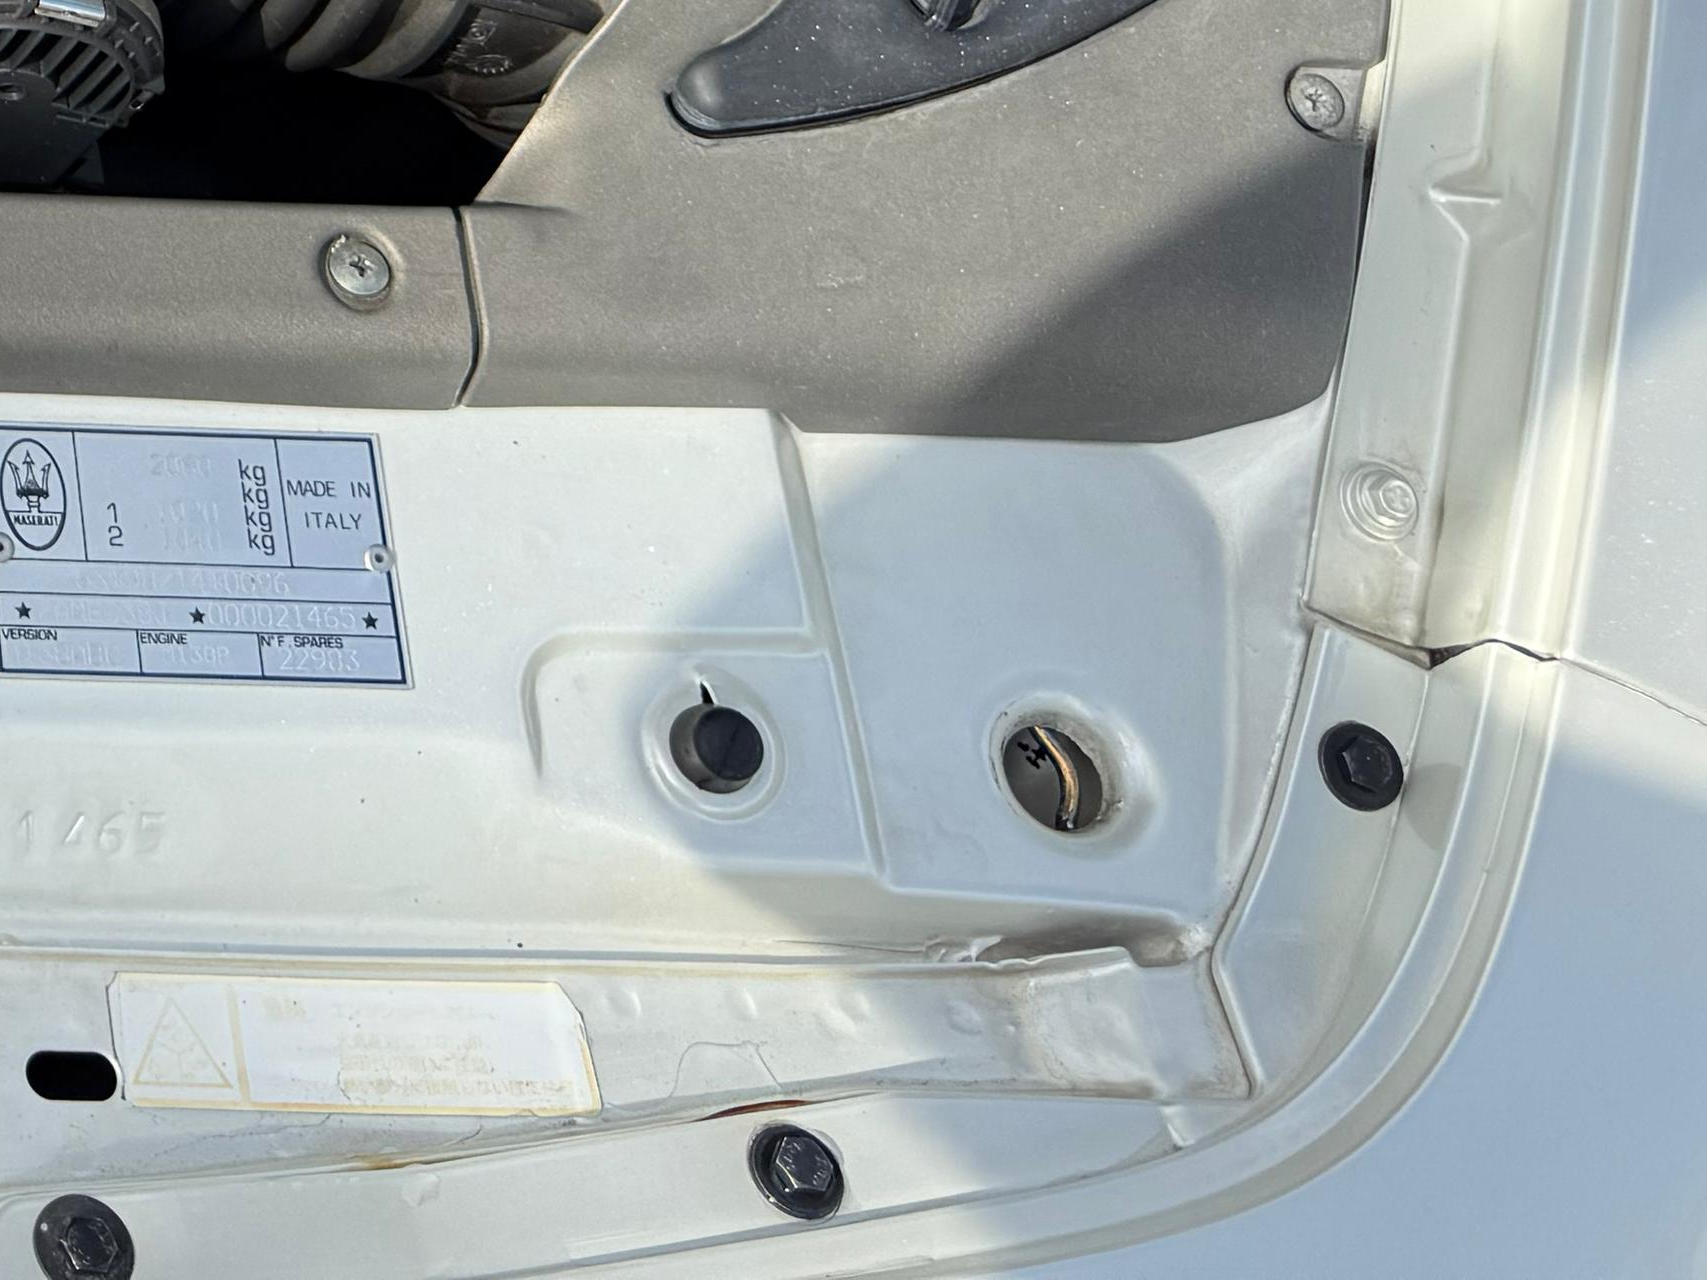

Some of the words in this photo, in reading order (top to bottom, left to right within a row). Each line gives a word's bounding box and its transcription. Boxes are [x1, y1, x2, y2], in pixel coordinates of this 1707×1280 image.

[238, 459, 267, 487] kg
[242, 483, 270, 510] kg
[286, 479, 337, 498] MADE
[350, 481, 371, 498] IN
[13, 515, 58, 526] MASERATI
[107, 503, 119, 523] 1
[245, 505, 273, 532] kg
[305, 511, 362, 531] ITALY
[108, 527, 125, 548] 2
[248, 529, 276, 556] kg
[1, 628, 58, 641] VERSION
[139, 631, 189, 645] ENGINE
[293, 635, 344, 649] SPARES
[278, 648, 360, 672] 22903
